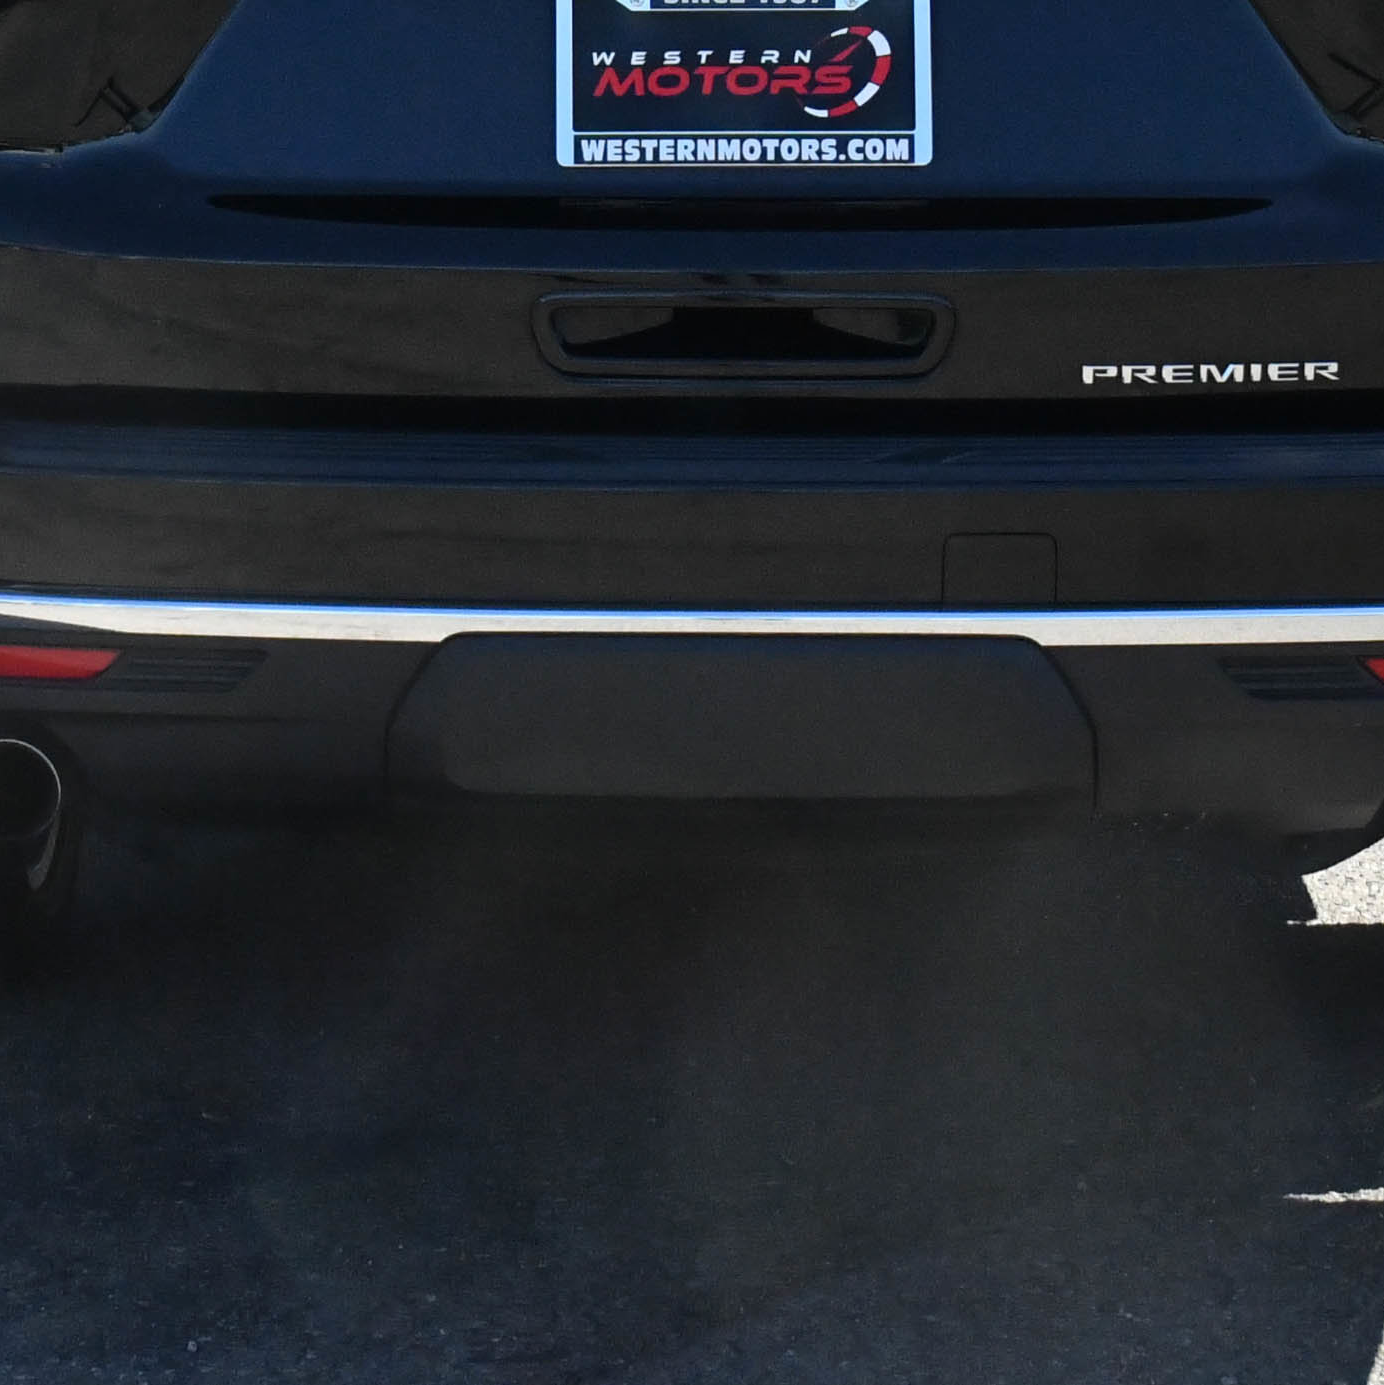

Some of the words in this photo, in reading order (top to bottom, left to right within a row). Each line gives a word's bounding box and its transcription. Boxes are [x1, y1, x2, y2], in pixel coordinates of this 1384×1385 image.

[591, 49, 813, 66] WESTERN
[591, 64, 855, 98] MOTORS
[580, 137, 911, 163] WESTERNMOTORS.COM
[1081, 361, 1340, 385] PREMIER
